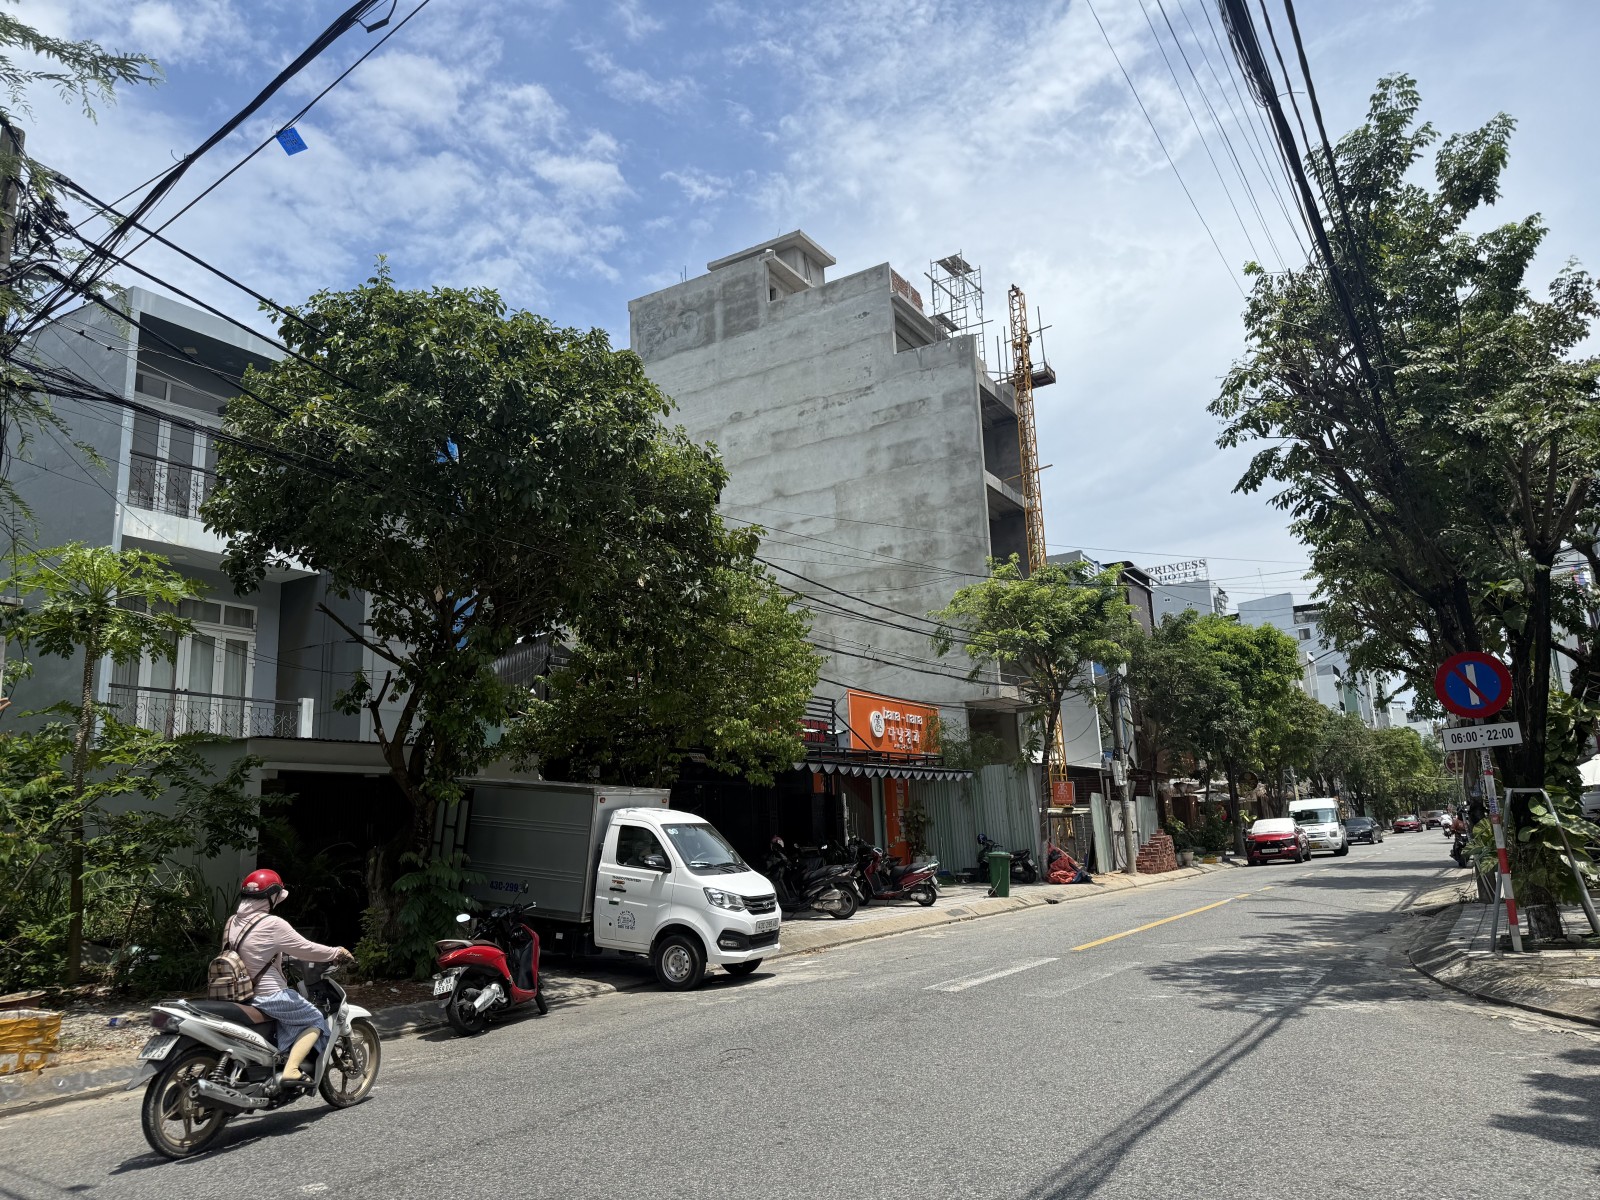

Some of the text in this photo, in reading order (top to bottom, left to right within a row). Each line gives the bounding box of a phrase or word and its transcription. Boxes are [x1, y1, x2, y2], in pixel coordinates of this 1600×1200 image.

[1148, 558, 1207, 575] PRINCESS
[1159, 571, 1199, 582] HOTEL
[1451, 731, 1478, 744] 06:00
[1486, 727, 1514, 741] 22:00
